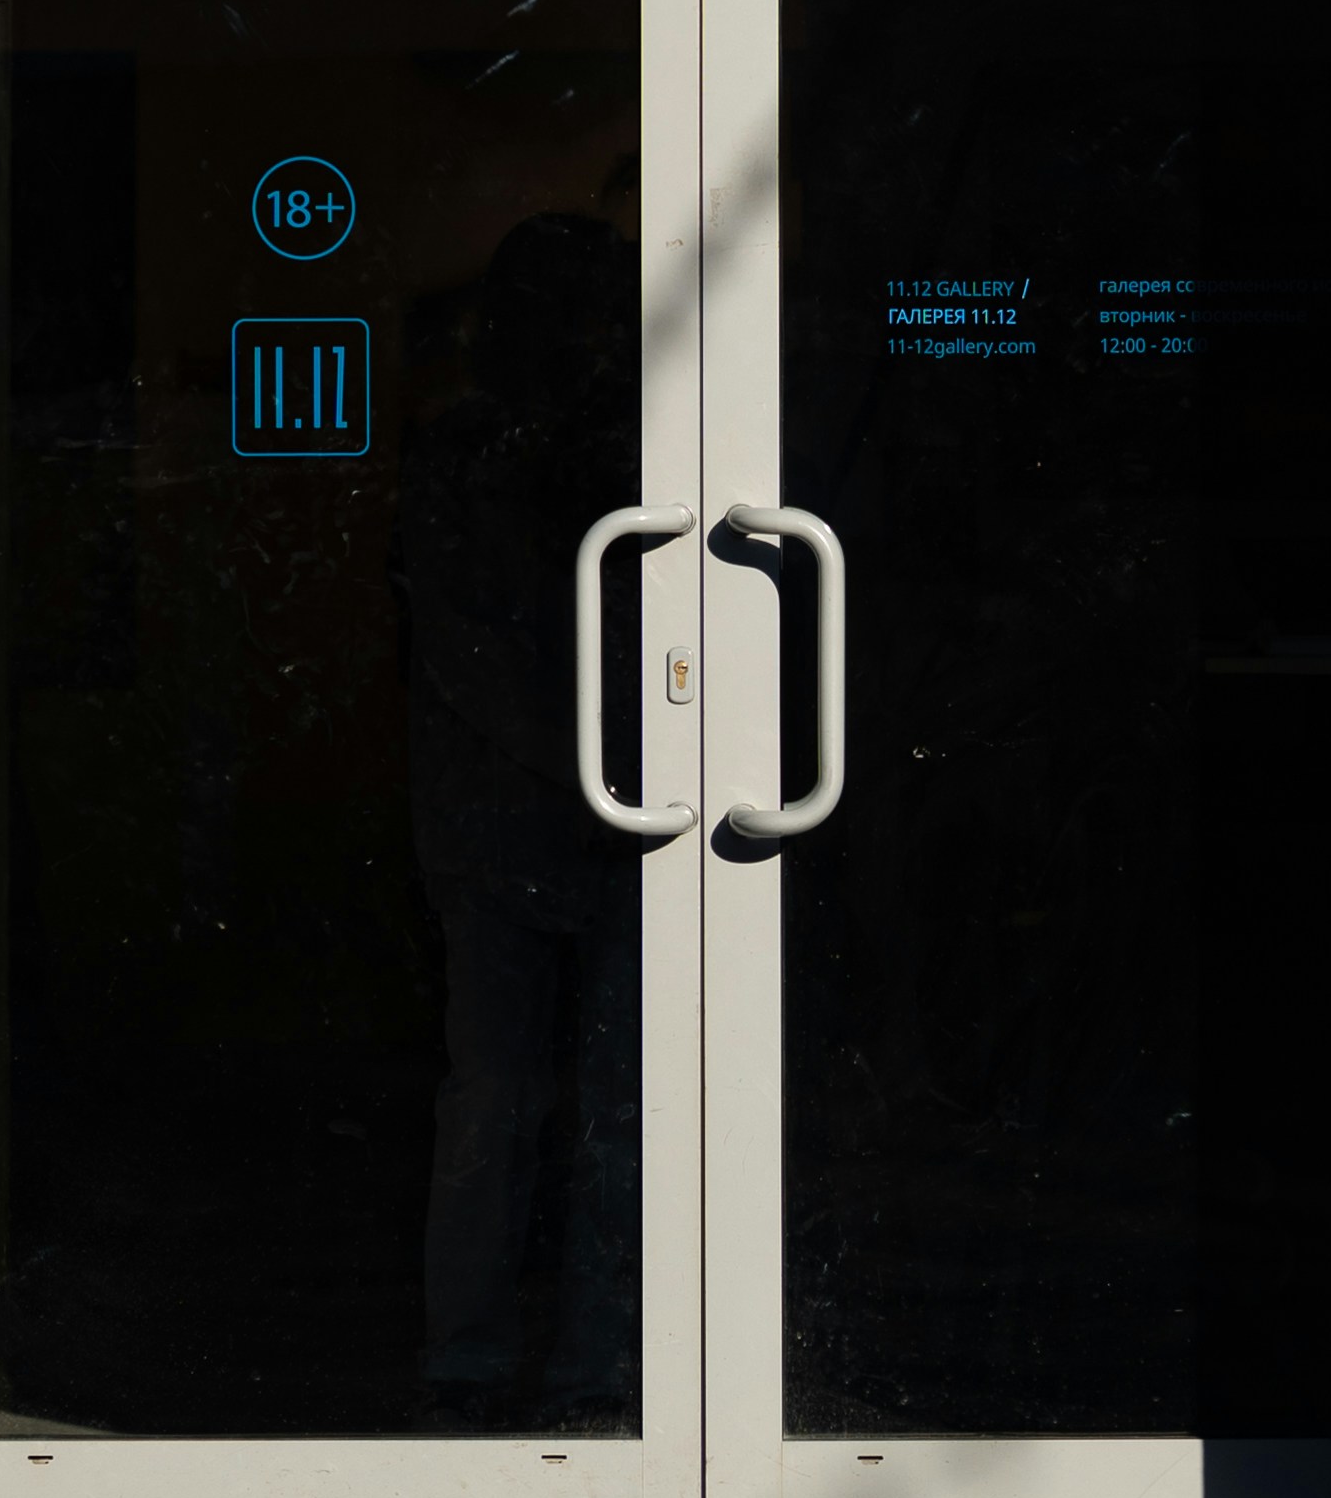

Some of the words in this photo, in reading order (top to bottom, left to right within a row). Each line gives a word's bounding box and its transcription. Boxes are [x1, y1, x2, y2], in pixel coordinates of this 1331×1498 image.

[266, 189, 345, 228] 18+
[886, 280, 932, 297] 11.12
[936, 280, 1015, 297] GALLERY
[1099, 280, 1171, 298] галерея
[888, 308, 966, 325] ГАЛЕРЕЯ
[971, 308, 1017, 325] 11.12
[1099, 310, 1175, 327] вторник
[887, 337, 1036, 359] 11-12gallery.com
[1100, 337, 1146, 354] 12:00
